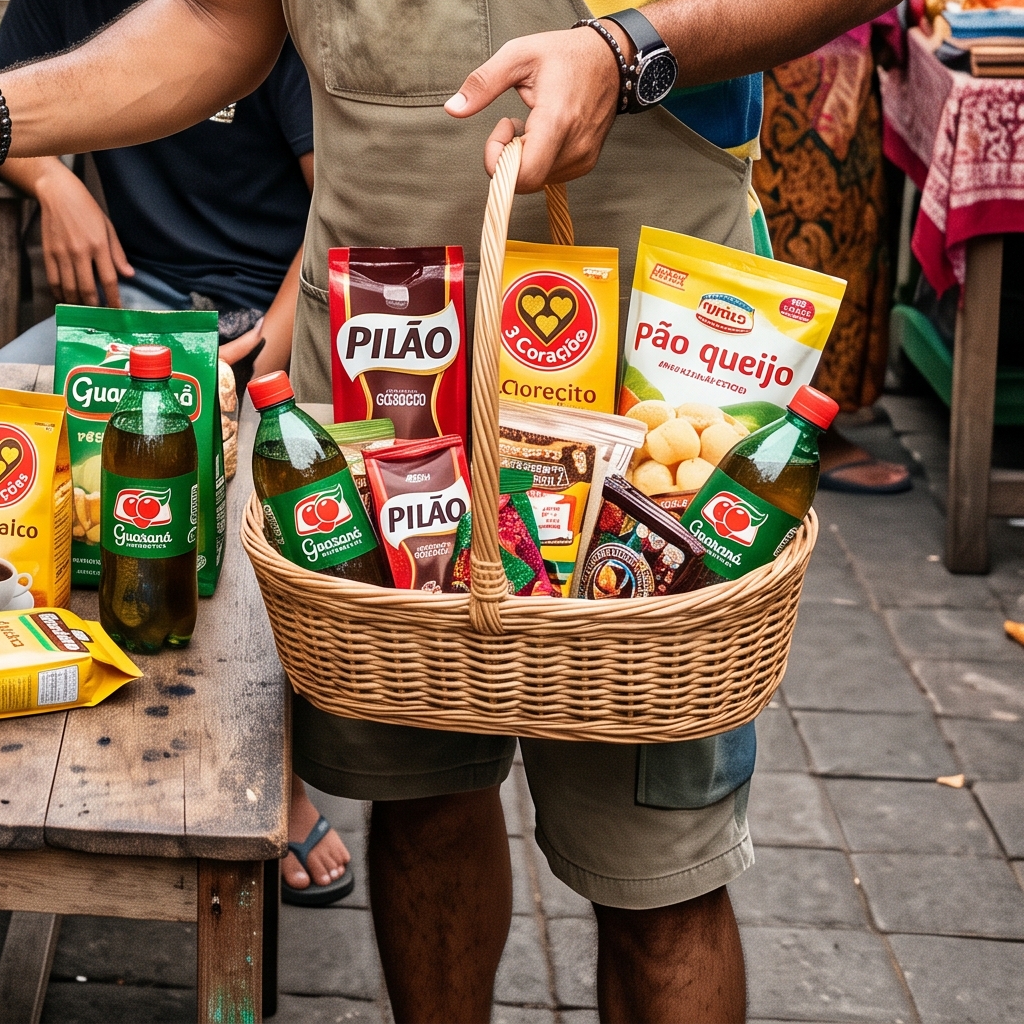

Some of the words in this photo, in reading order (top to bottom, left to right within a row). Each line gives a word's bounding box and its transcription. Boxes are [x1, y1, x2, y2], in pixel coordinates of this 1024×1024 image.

[345, 320, 453, 360] PILÃO
[505, 325, 520, 338] 3
[634, 321, 690, 355] pão
[698, 342, 795, 389] queijo
[388, 494, 467, 534] PILÃO
